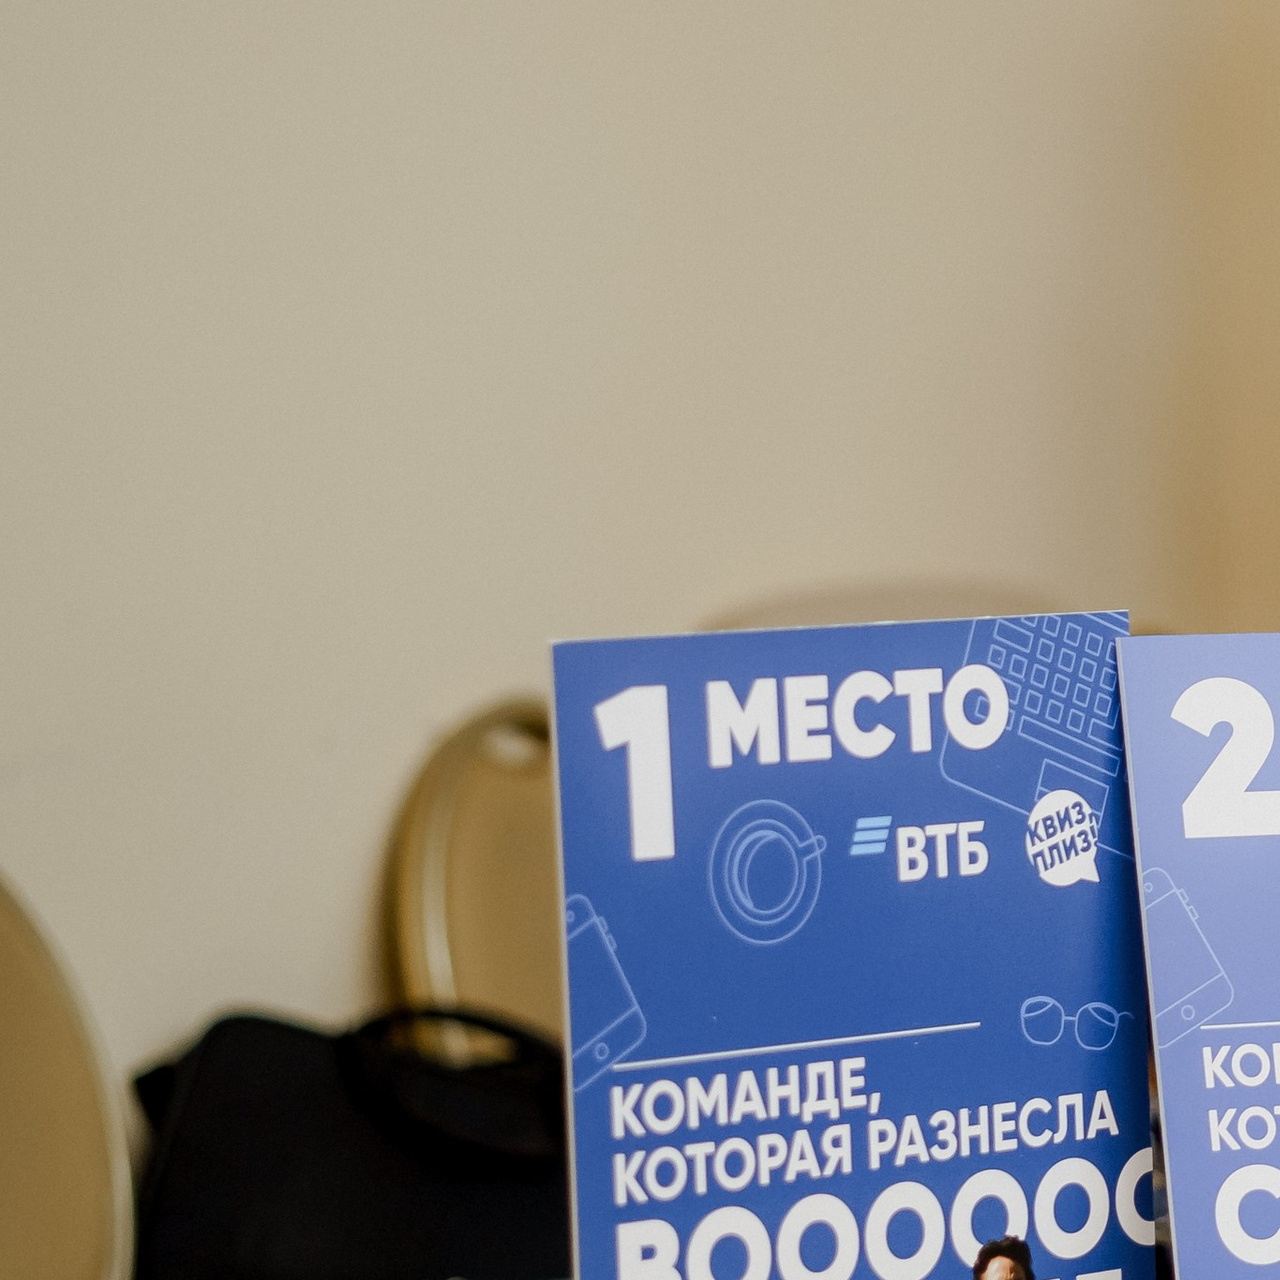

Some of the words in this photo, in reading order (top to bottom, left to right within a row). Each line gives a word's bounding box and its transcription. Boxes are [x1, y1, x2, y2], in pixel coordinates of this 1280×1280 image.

[592, 685, 676, 861] 1
[705, 663, 1009, 769] МЕСТО
[896, 820, 989, 883] ВТБ
[610, 1056, 881, 1140] КОМАНДЕ,
[612, 1123, 853, 1207] КОТОРАЯ
[867, 1089, 1119, 1170] РАЗНЕСЛА
